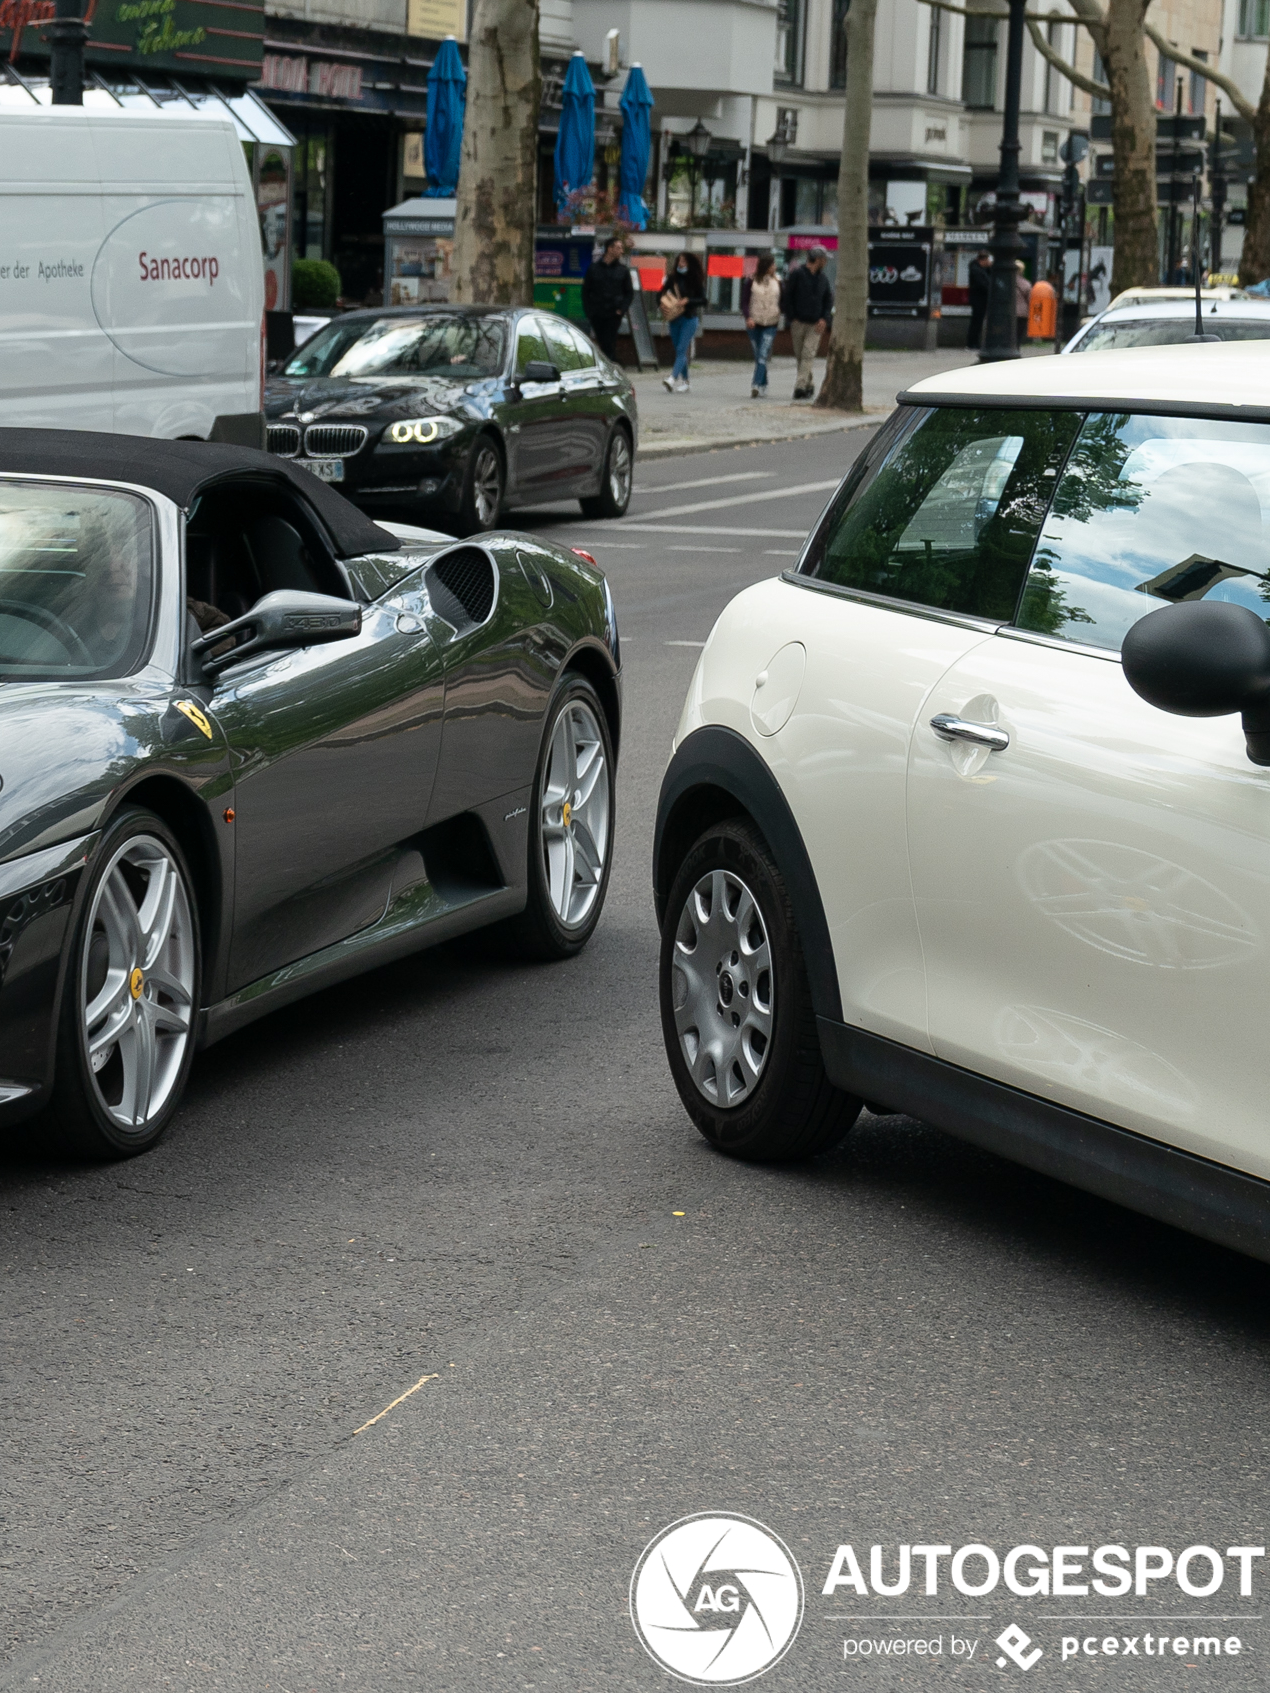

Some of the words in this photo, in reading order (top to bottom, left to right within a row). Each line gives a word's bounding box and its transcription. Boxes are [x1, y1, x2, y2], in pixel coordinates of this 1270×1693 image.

[13, 261, 29, 279] der
[38, 259, 84, 283] Apotheke
[139, 252, 219, 286] Sanacorp
